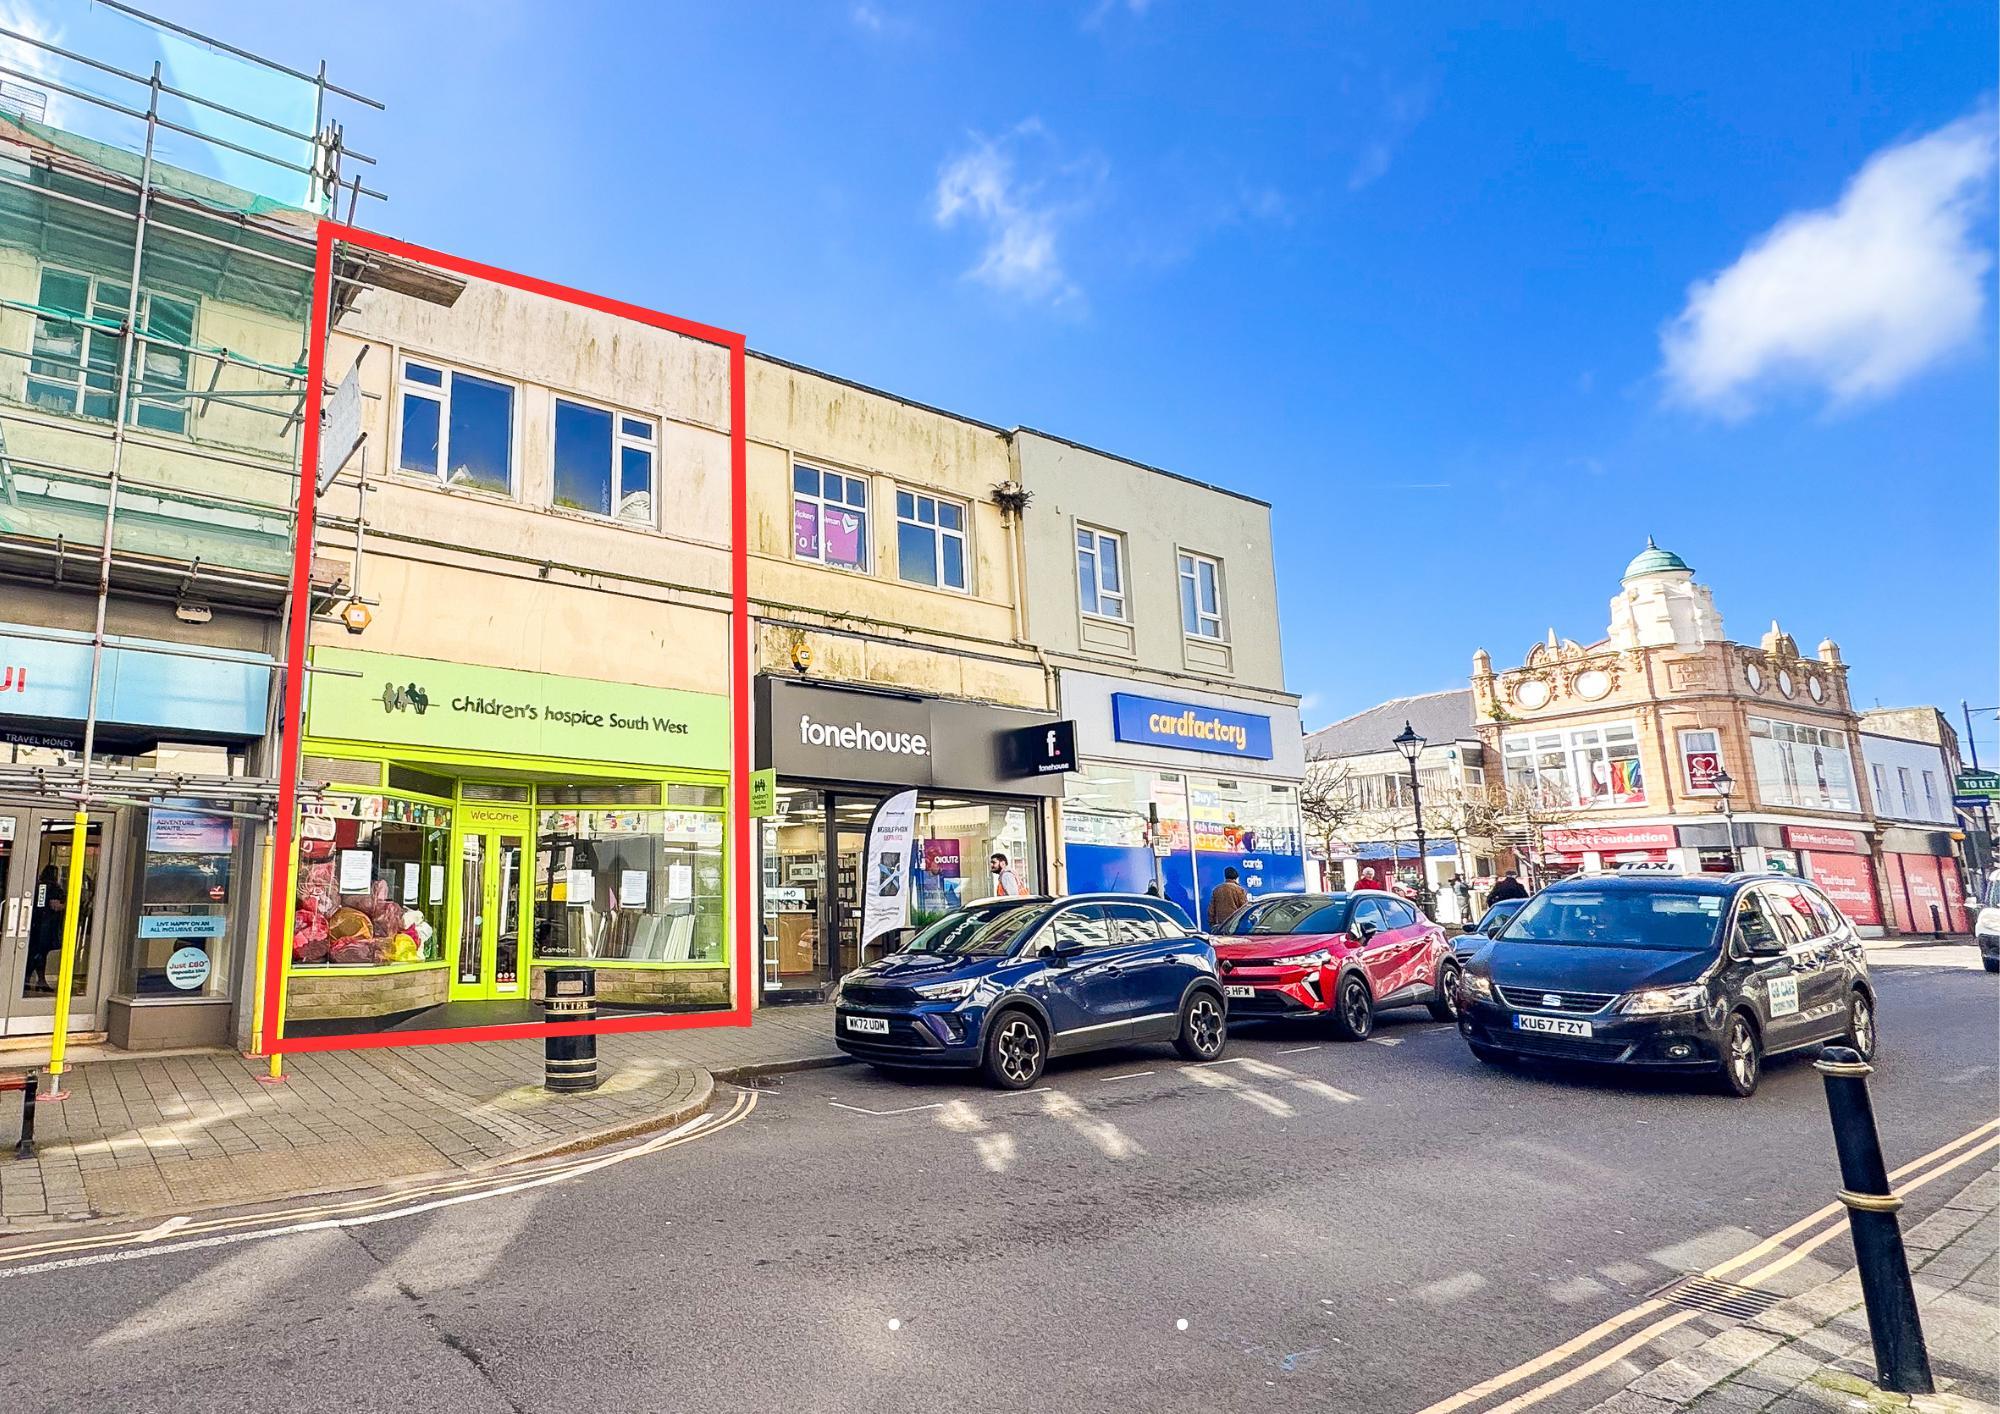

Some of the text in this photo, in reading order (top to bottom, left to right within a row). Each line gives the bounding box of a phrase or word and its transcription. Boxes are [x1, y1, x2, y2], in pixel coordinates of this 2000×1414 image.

[811, 534, 833, 553] Lt
[544, 706, 604, 727] hospice
[609, 713, 649, 731] South
[652, 717, 689, 735] West
[1149, 711, 1247, 750] cardfactory
[5, 733, 75, 748] TRAVEL MONEY
[1963, 780, 1997, 788] TO LET
[470, 810, 519, 822] Welcome
[1593, 831, 1668, 845] Foundation
[1242, 858, 1263, 870] cards
[1625, 862, 1675, 871] TAXI
[1231, 986, 1250, 995] HFW
[553, 1001, 589, 1010] LITTER
[1520, 1016, 1584, 1034] KU67 FZY
